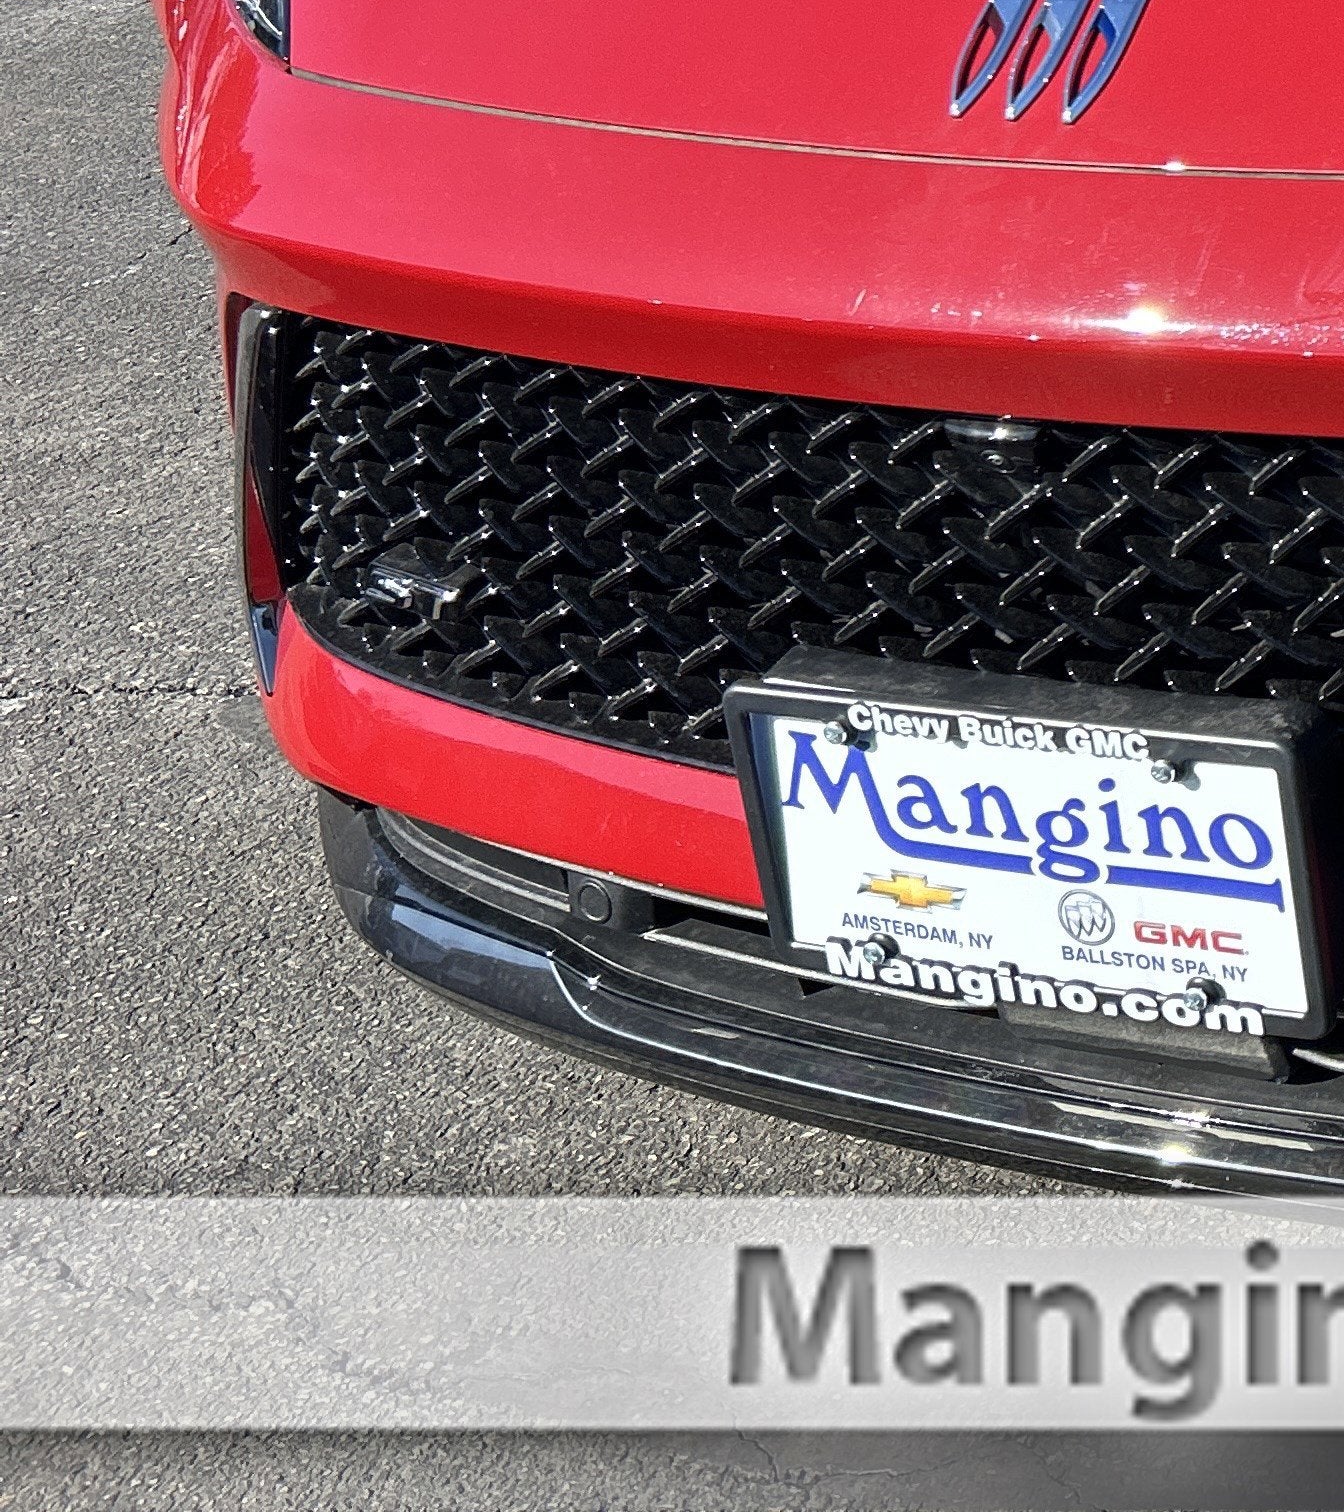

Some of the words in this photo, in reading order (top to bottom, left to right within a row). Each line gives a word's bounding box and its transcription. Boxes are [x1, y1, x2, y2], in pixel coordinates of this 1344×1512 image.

[846, 701, 950, 743] Chevy
[957, 715, 1058, 752] Buick
[1064, 725, 1150, 761] GMC
[782, 731, 1285, 912] Mangino
[840, 913, 965, 948] AMSTERDAM,
[967, 931, 994, 950] NY
[1133, 920, 1246, 956] GMC
[824, 937, 1266, 1036] Mangino.com
[1060, 945, 1166, 972] BALLSTON
[1171, 959, 1216, 980] SPA,
[1221, 963, 1249, 982] NY
